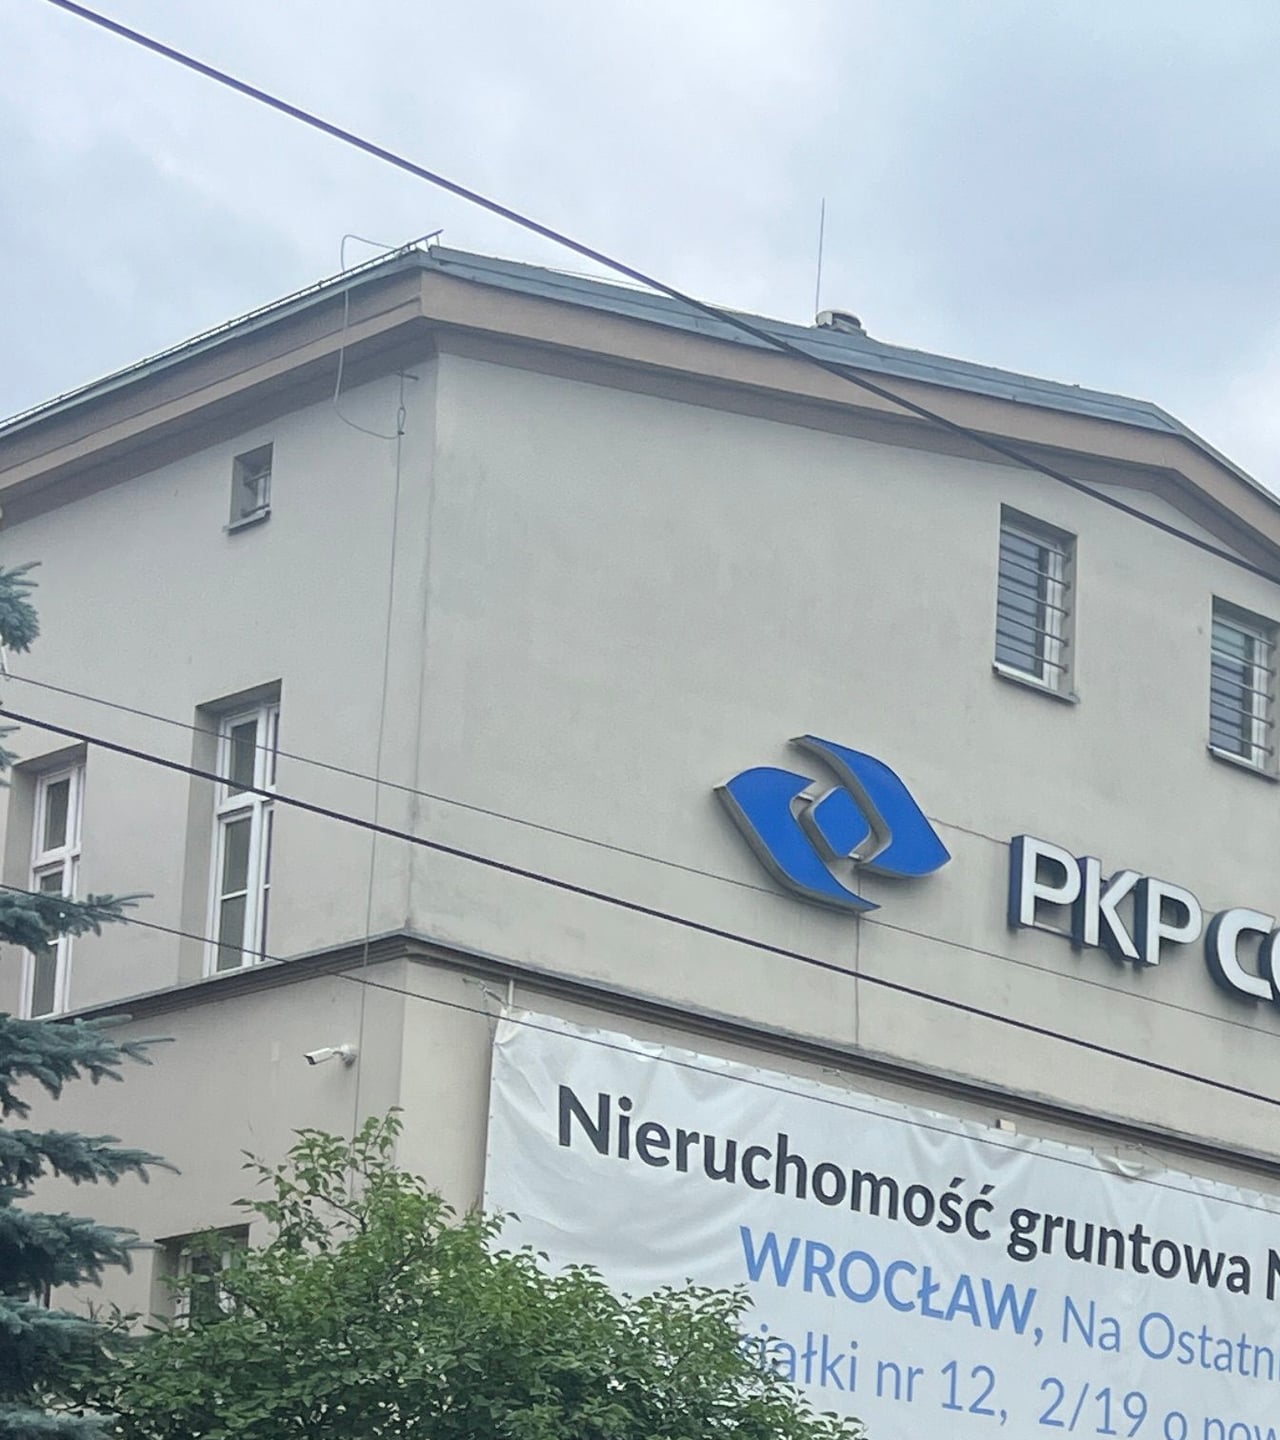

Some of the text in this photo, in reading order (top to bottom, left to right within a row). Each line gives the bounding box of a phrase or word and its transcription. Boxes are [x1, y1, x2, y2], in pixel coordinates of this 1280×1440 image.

[1008, 835, 1203, 966] PKP
[557, 1083, 995, 1241] Nieruchomość
[1007, 1207, 1252, 1296] gruntowa
[739, 1225, 1044, 1347] WROCŁAW,
[1062, 1296, 1122, 1353] Na
[876, 1358, 925, 1402] nr
[941, 1360, 1009, 1427] 12,
[1038, 1377, 1149, 1439] 2/19
